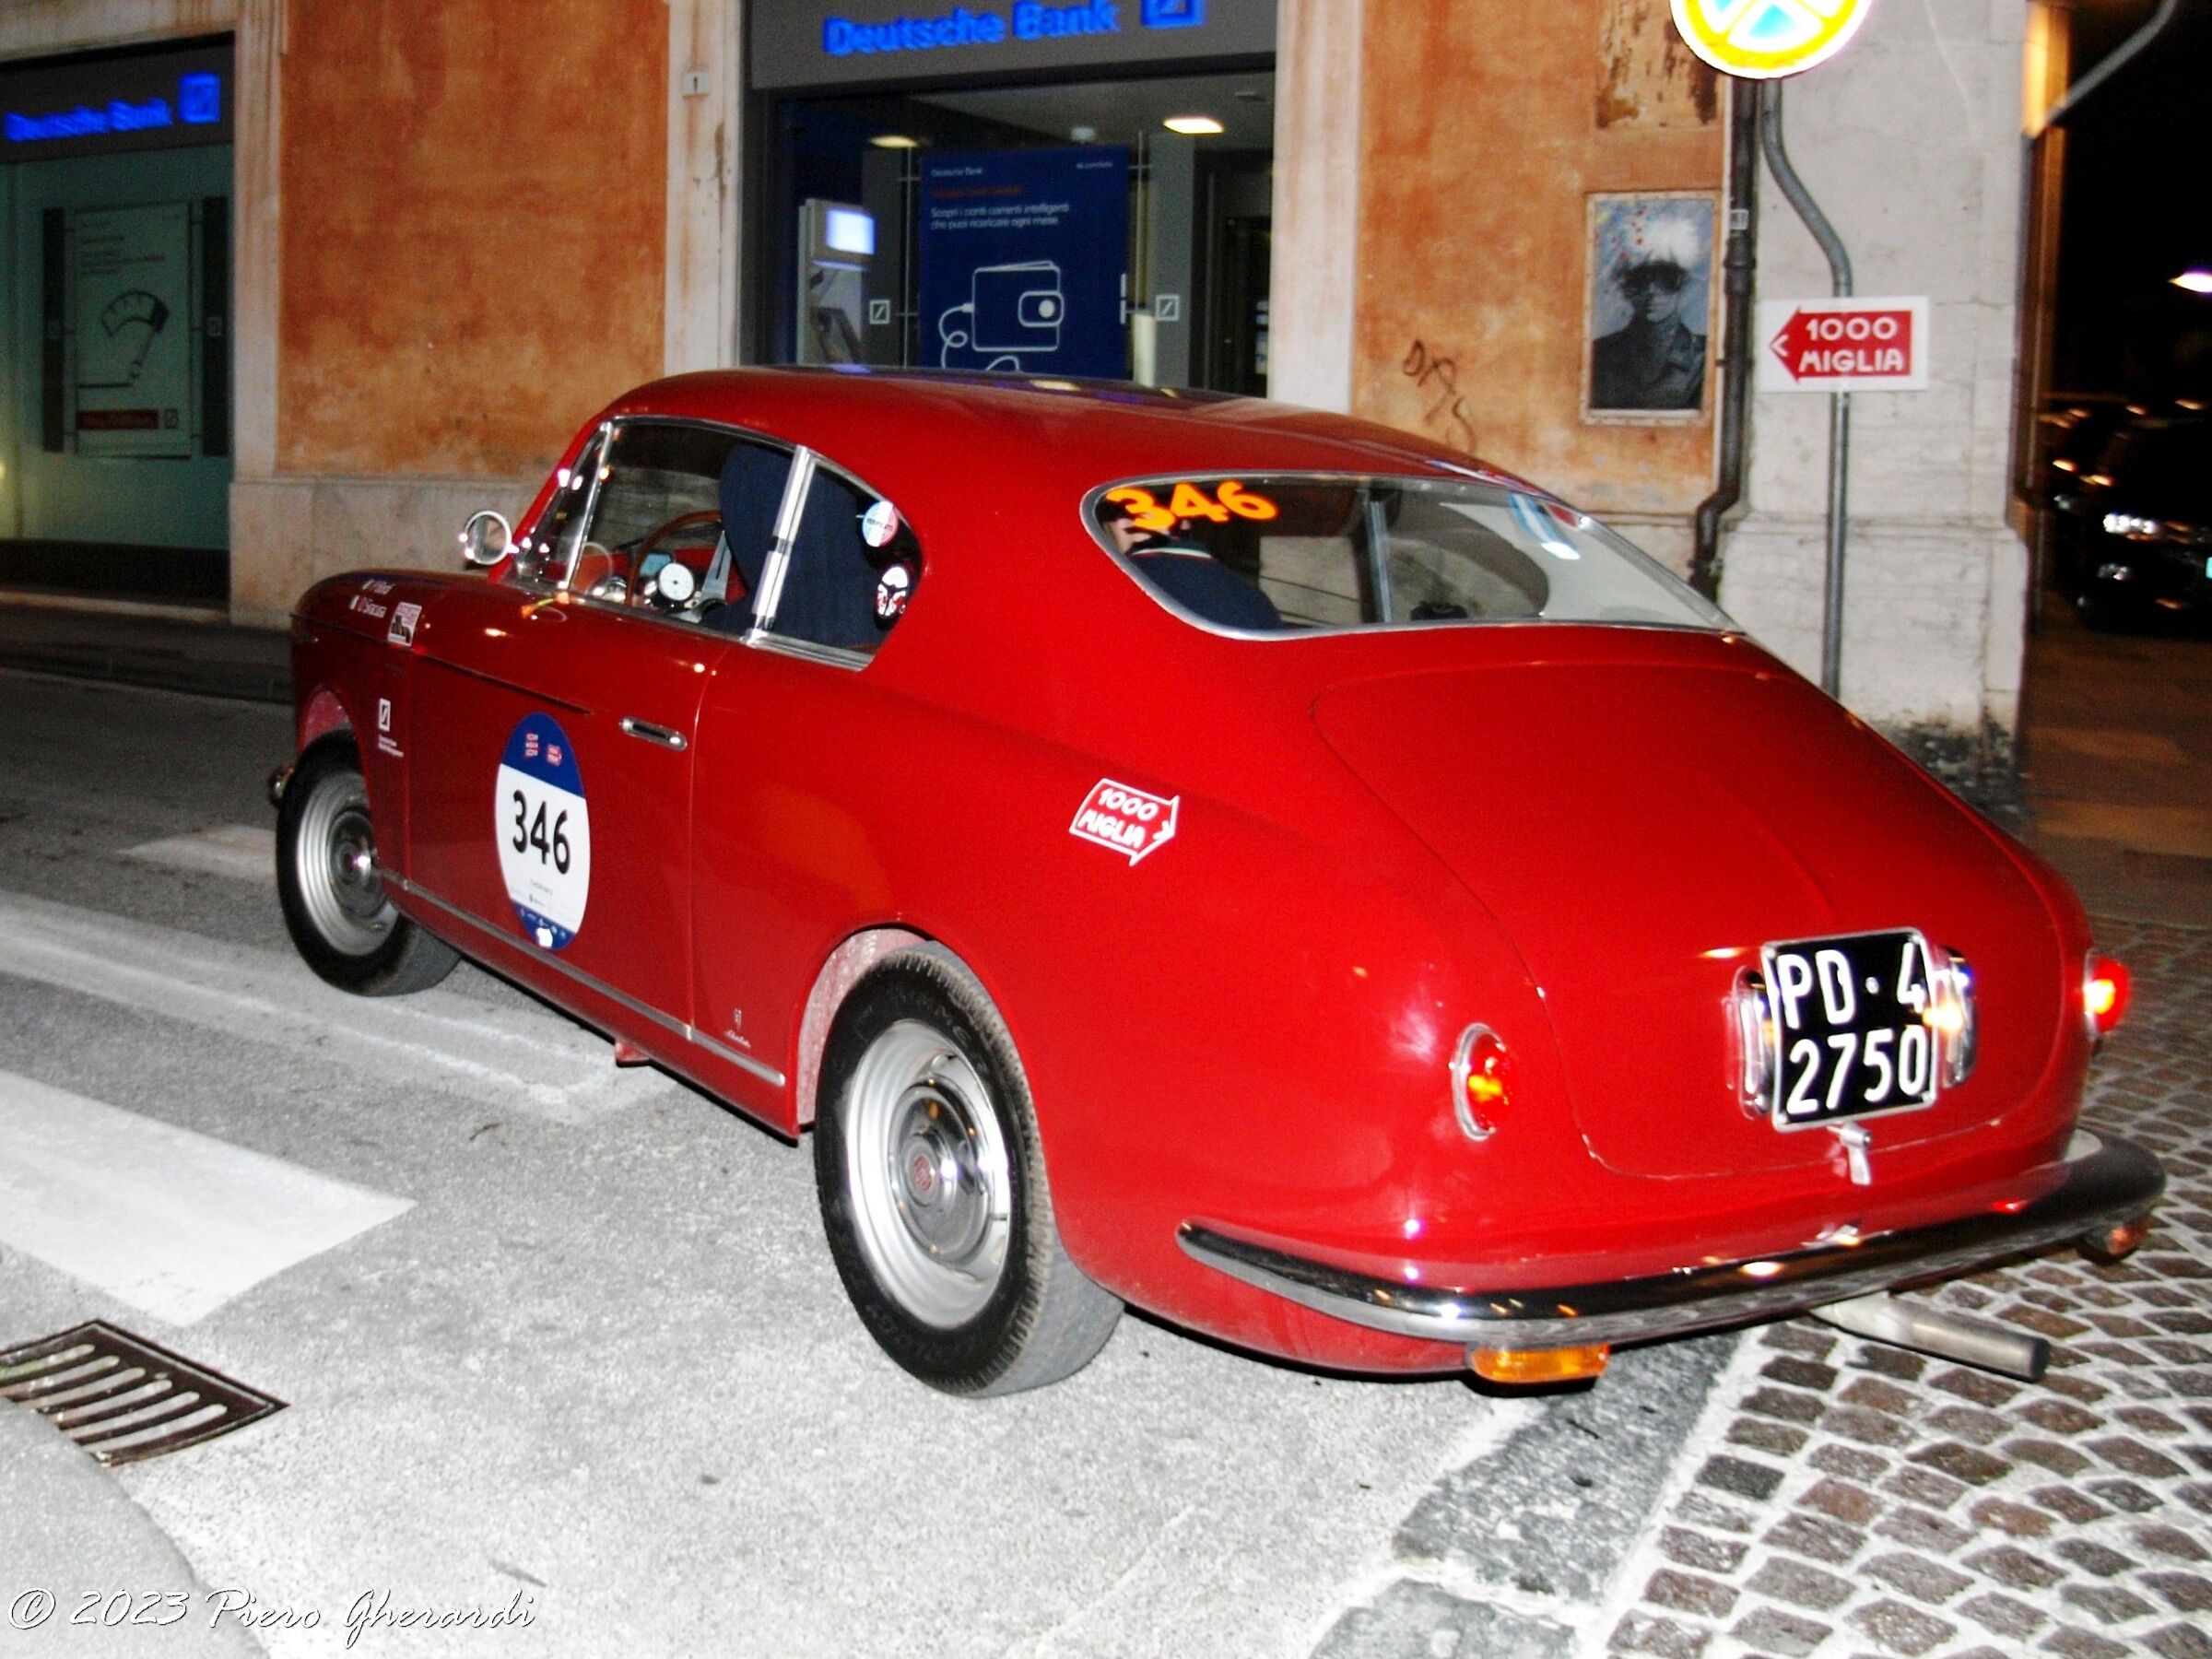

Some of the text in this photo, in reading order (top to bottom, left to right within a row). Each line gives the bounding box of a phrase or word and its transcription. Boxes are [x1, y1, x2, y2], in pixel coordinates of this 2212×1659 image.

[823, 0, 1119, 56] Deutsche Bank
[1806, 316, 1898, 341] 1000
[1798, 348, 1903, 372] MIGLIA
[1106, 480, 1277, 530] 346
[1098, 788, 1159, 821] 1000
[512, 789, 571, 875] 346
[1786, 1024, 1927, 1115] 2750
